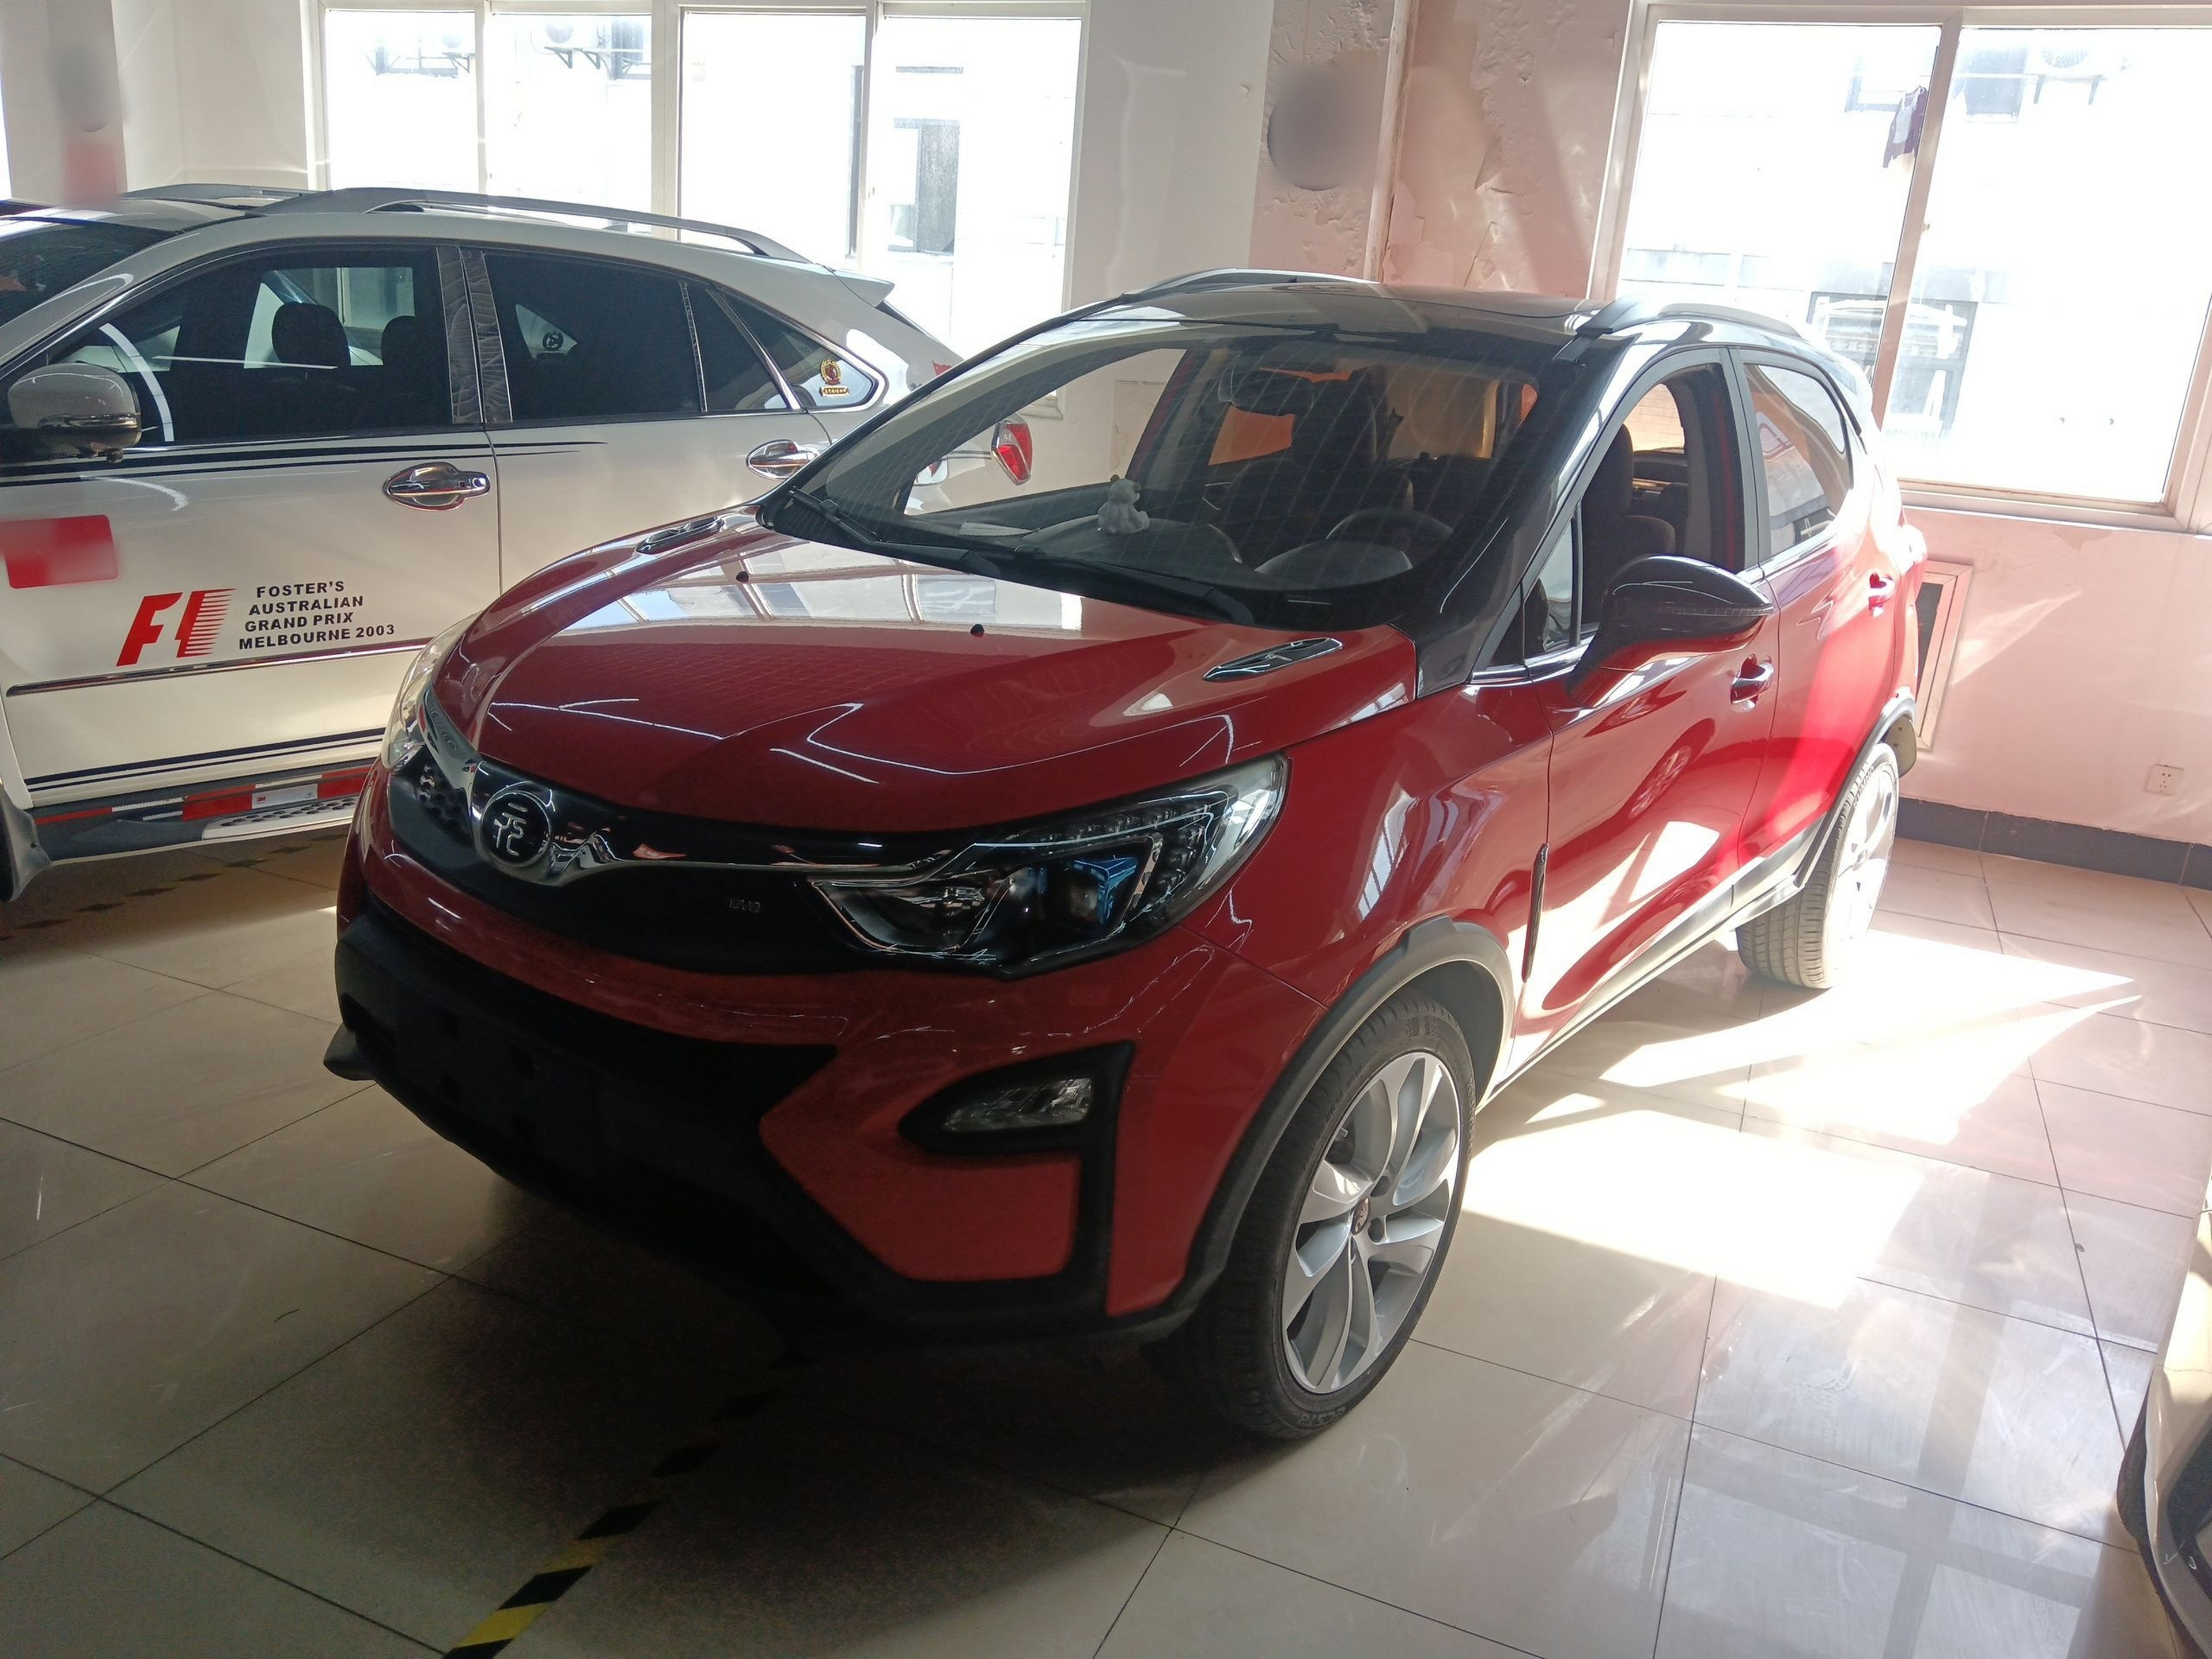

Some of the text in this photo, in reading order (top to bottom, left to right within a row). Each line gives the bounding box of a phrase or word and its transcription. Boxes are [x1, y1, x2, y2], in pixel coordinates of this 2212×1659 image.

[257, 581, 344, 598] FOSTER'S
[249, 596, 363, 615] AUSTRALIAN
[116, 588, 237, 666] F1
[245, 612, 354, 632] GRAND PRIX
[239, 624, 395, 649] MELBOURNE 2003
[494, 802, 528, 856] 元
